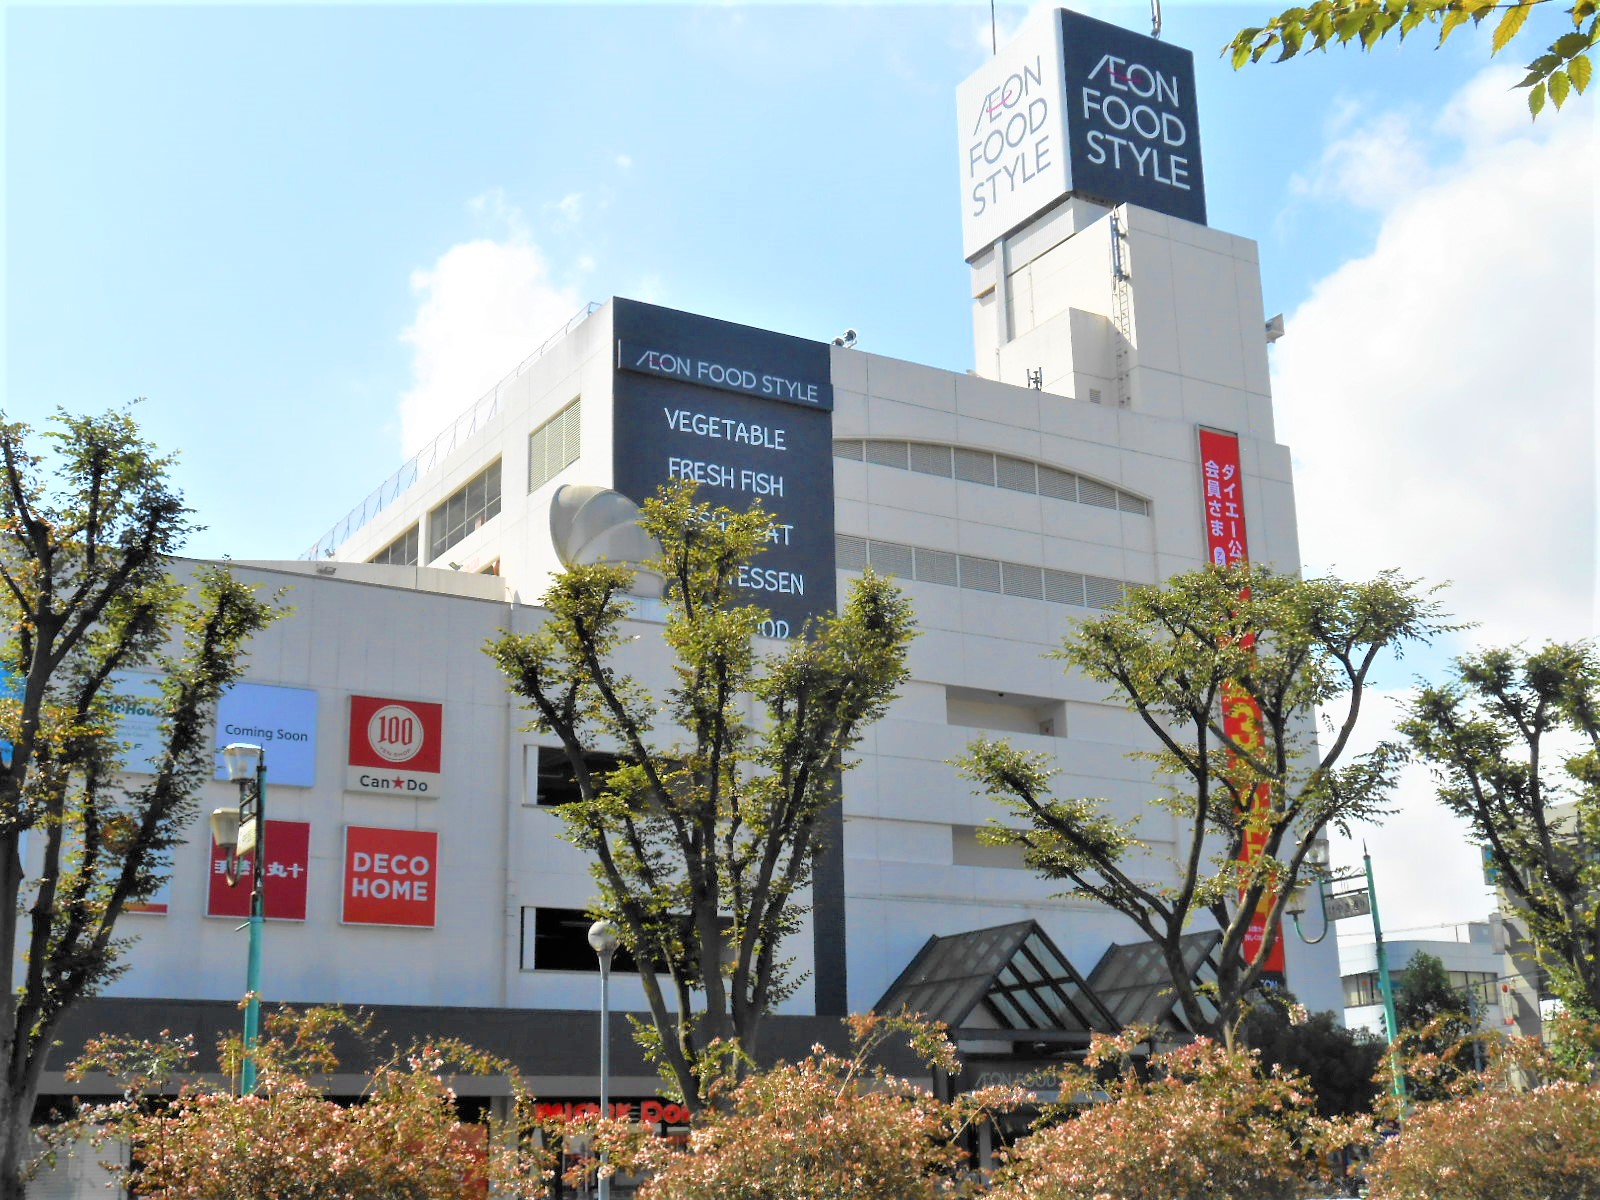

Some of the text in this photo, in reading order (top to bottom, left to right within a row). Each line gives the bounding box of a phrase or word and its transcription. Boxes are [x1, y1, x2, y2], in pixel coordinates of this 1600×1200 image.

[969, 97, 1048, 178] FOOD
[1082, 86, 1186, 147] FOOD
[973, 134, 1051, 217] STYLE
[1086, 130, 1190, 190] STYLE
[698, 361, 757, 389] FOOD
[762, 375, 819, 403] STYLE
[664, 407, 787, 450] VEGETABLE
[669, 457, 784, 497] FRESH FISH
[1204, 460, 1224, 537] 会員さま
[225, 724, 308, 742] Coming Soon
[378, 715, 413, 745] 100
[360, 774, 428, 792] Can Do
[353, 852, 431, 876] DECO
[352, 877, 428, 902] HOME
